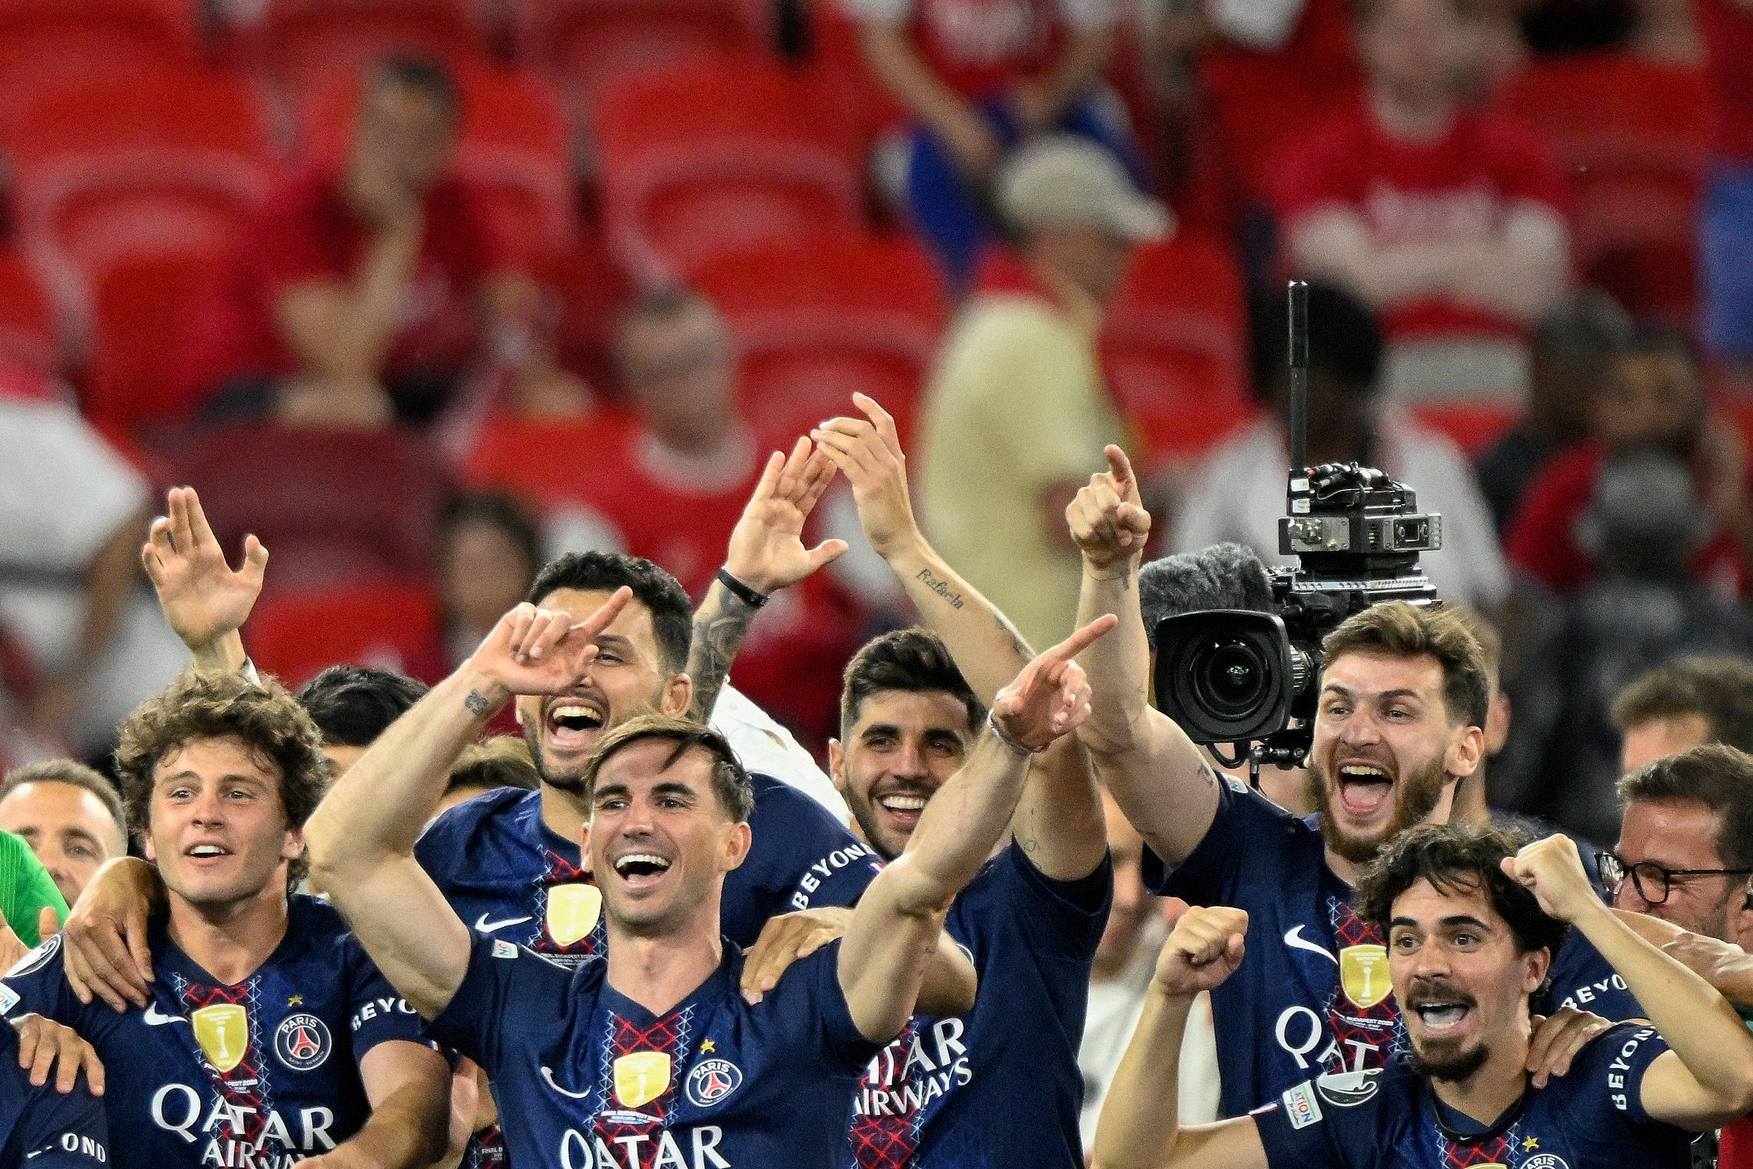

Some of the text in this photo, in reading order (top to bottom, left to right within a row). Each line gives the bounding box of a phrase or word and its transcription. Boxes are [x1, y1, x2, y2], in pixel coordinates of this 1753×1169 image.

[915, 568, 965, 610] Rafaela
[281, 1016, 319, 1034] PARIS
[692, 1061, 731, 1080] PARIS
[151, 1083, 337, 1151] QATAR
